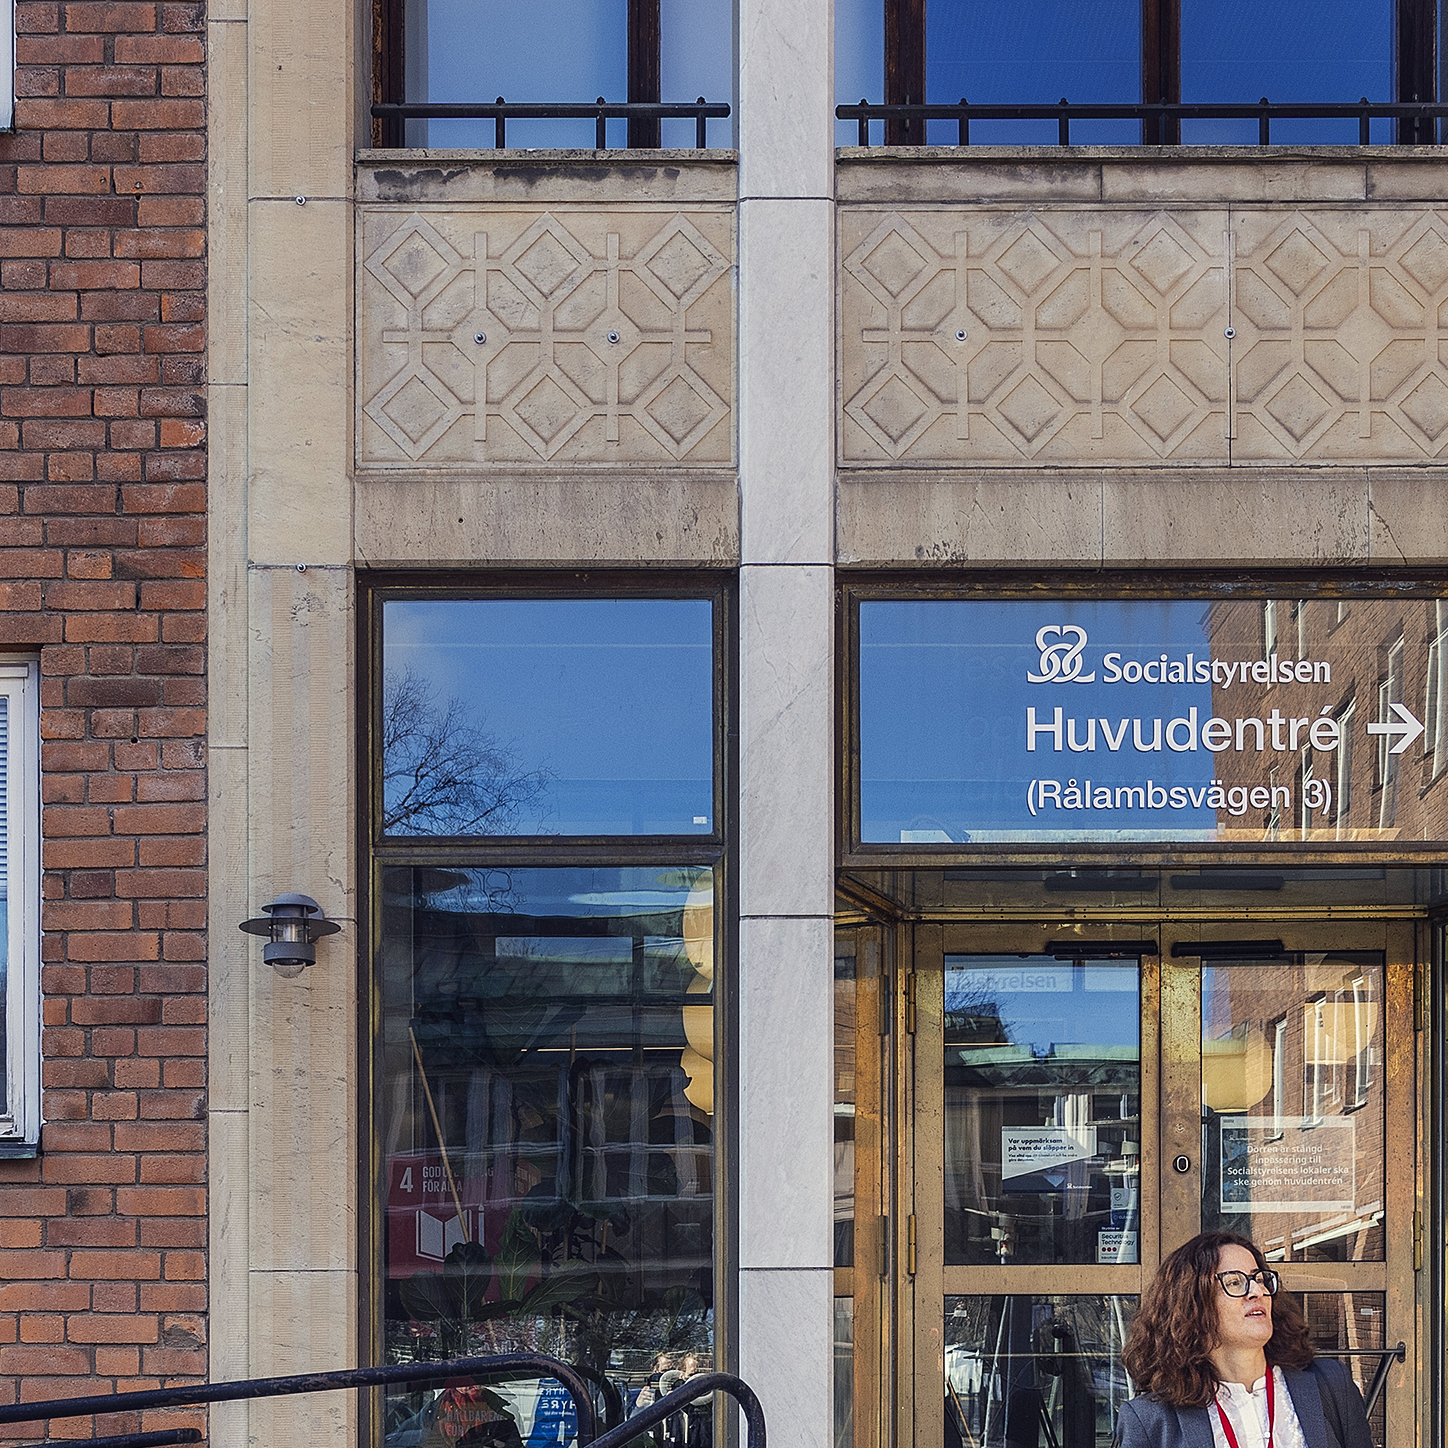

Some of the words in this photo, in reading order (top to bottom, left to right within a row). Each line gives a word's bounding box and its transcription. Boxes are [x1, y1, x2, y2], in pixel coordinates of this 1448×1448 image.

[1102, 652, 1332, 690] Socialstyrelsen
[1025, 705, 1341, 753] Huvudentré
[1026, 778, 1291, 816] (Rålambsvägen
[1303, 778, 1333, 815] 3)
[1021, 1137, 1062, 1146] uppmärksam
[1291, 1144, 1323, 1155] stängd
[1255, 1156, 1307, 1165] inpassering
[422, 1166, 442, 1178] GOD
[1227, 1167, 1299, 1177] Socialstyrelsens
[1300, 1166, 1331, 1175] lokaler
[1333, 1166, 1349, 1174] ska
[399, 1166, 414, 1193] 4
[1233, 1178, 1249, 1186] ske
[1251, 1178, 1283, 1187] genom
[1284, 1177, 1343, 1186] huvudentrén
[422, 1180, 440, 1193] FÖR
[441, 1181, 463, 1192] ALA
